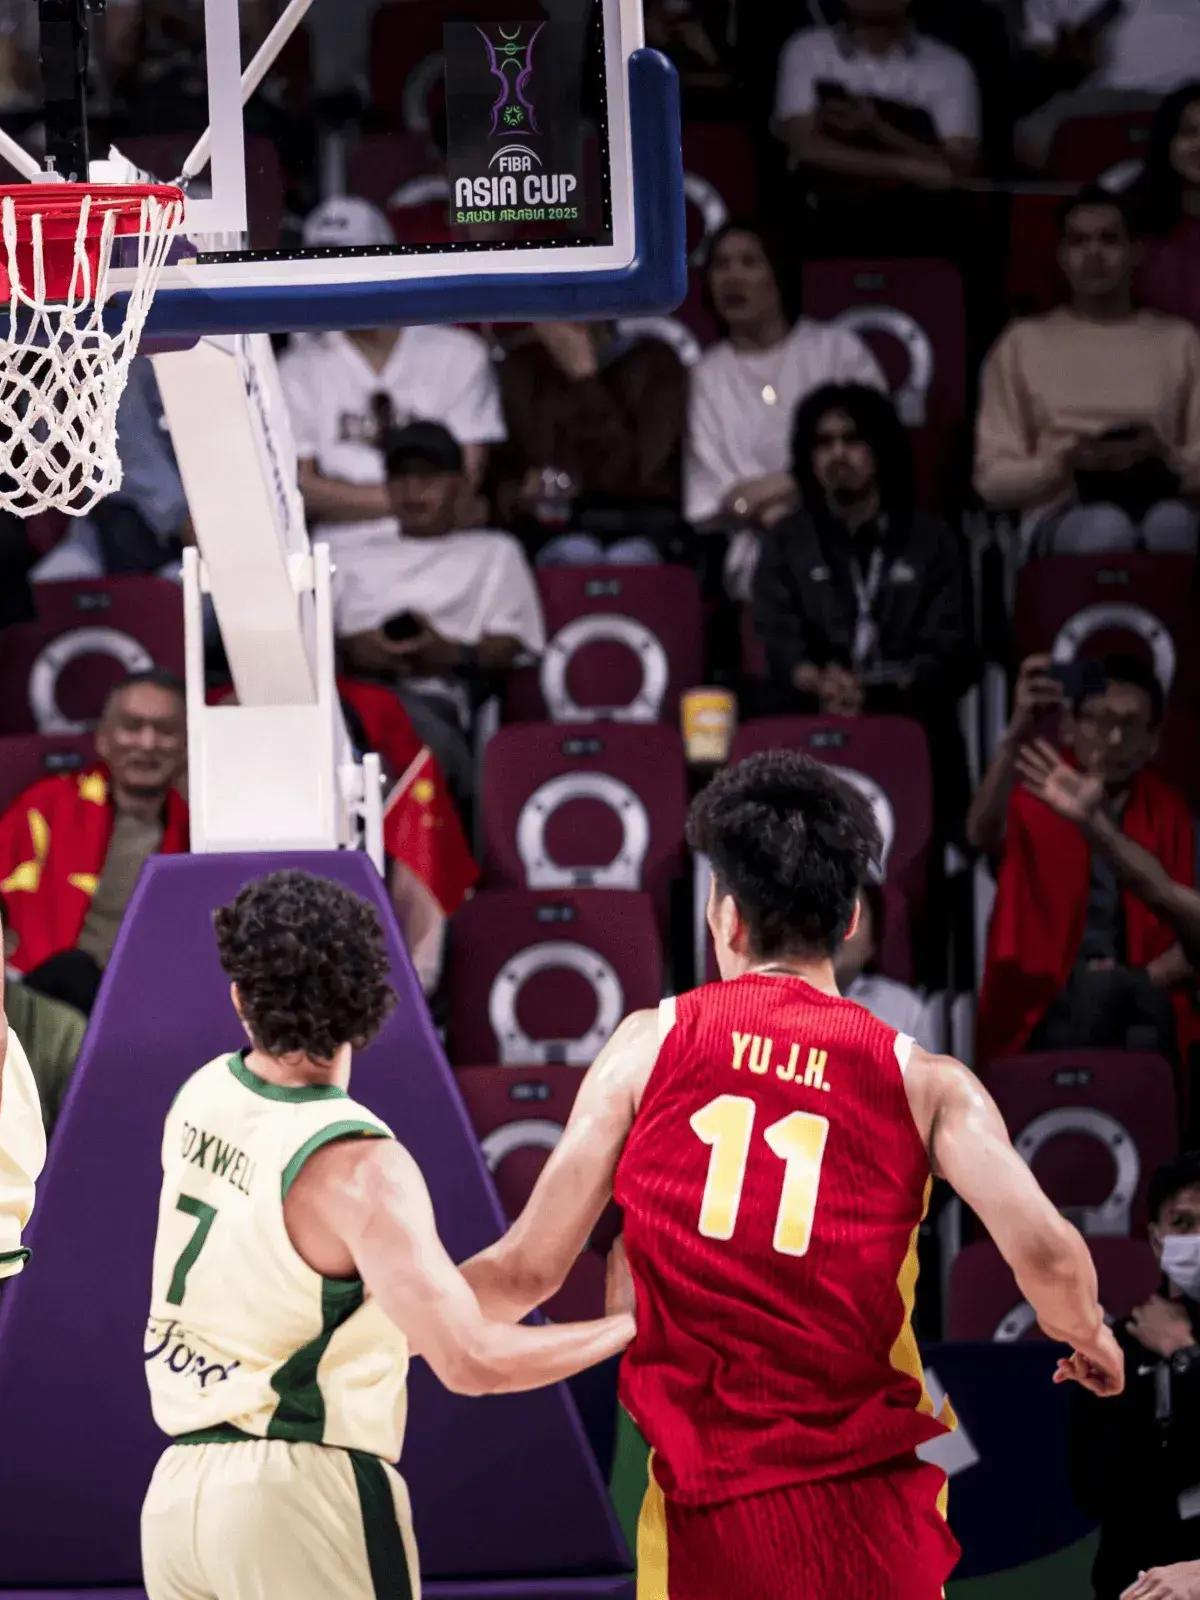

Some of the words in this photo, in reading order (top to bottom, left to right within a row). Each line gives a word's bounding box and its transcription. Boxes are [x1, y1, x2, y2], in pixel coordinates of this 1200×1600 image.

[455, 175, 517, 208] ASIA
[523, 173, 577, 205] CUP
[499, 156, 531, 172] FIBA
[456, 210, 495, 223] SAUDI
[500, 208, 545, 221] ARABIA
[548, 207, 578, 219] 2025
[731, 1030, 773, 1076] YU
[775, 1042, 832, 1093] J.H.
[182, 1121, 257, 1197] OXWELL
[689, 1093, 830, 1258] 11
[166, 1192, 218, 1306] 7
